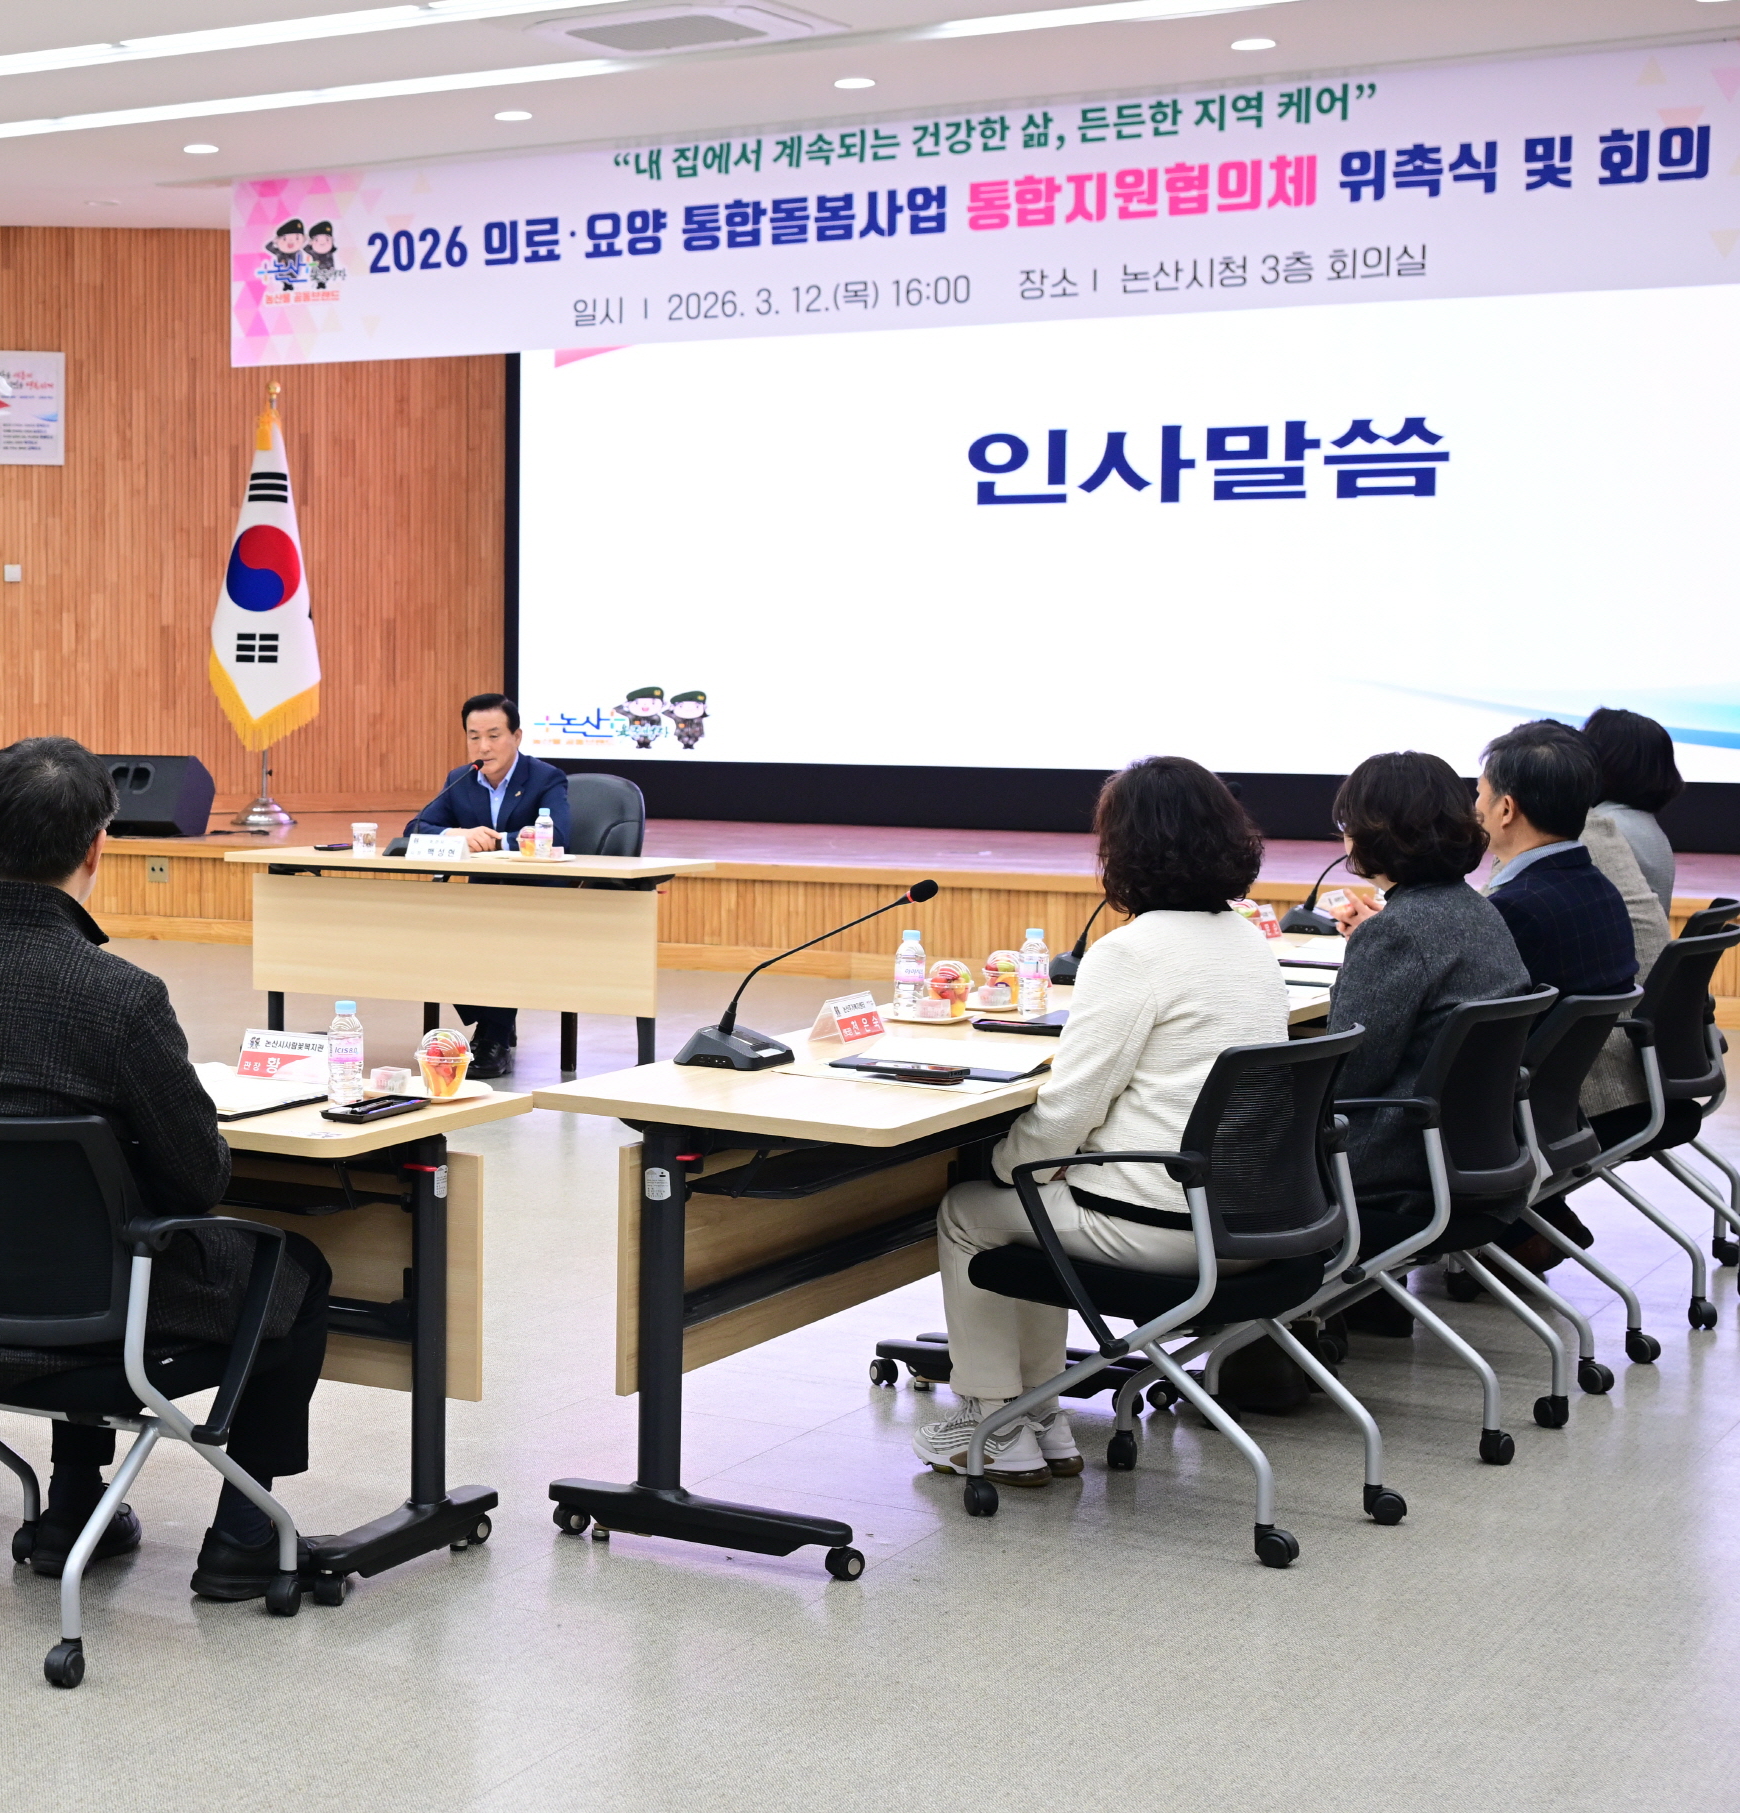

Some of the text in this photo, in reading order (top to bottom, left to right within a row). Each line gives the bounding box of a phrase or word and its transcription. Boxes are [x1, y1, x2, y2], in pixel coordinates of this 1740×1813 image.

[613, 82, 1377, 181] “내 집에서 계속되는 건강한 삶, 든든한 지역 케어”
[367, 225, 468, 274] 2026
[682, 185, 947, 252] 통합돌봄사업
[966, 153, 1317, 231] 통합지원협의체
[1339, 140, 1498, 203] 위촉식
[1524, 135, 1573, 191] 및
[1598, 125, 1711, 184] 회의
[574, 244, 1427, 327] 일시 2026. 3. 12.(목) 16:00 장소 논산시청 3층 회의실
[968, 417, 1450, 505] 인사말씀
[264, 1040, 325, 1052] 논산시사람꽃복지관
